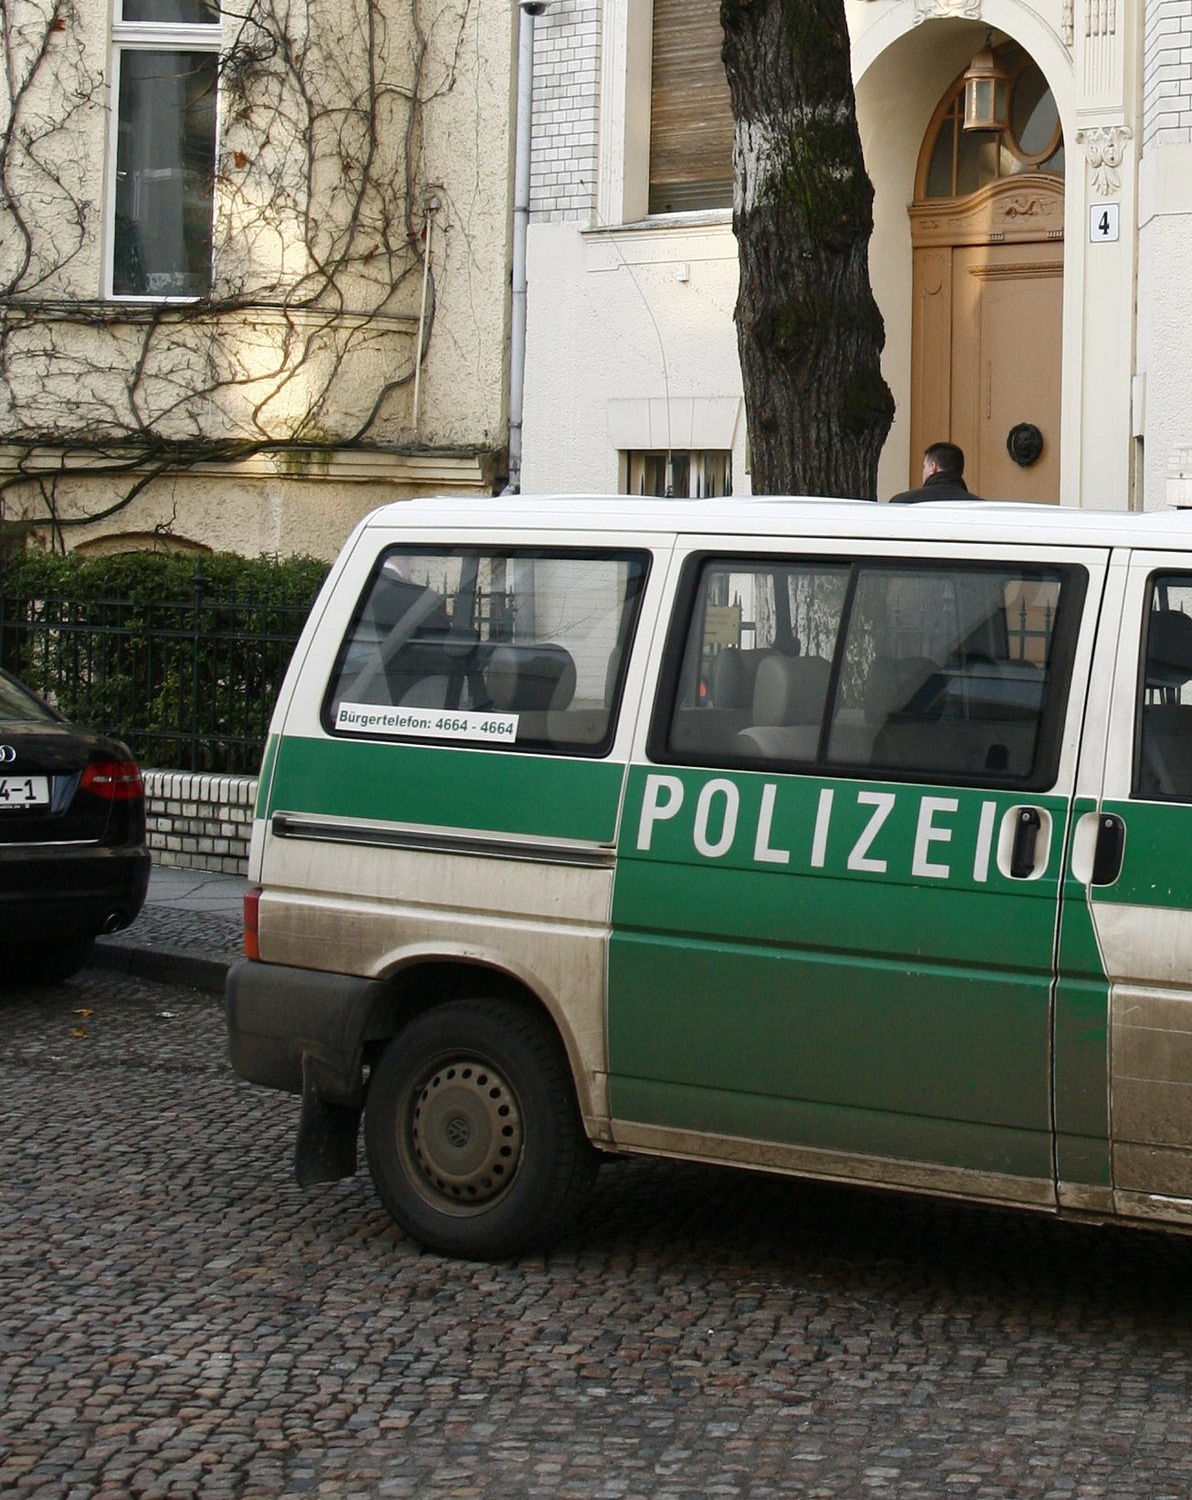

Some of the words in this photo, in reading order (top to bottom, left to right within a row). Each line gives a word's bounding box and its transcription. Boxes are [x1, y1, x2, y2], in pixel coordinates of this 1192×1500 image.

[1098, 211, 1110, 235] 4
[339, 710, 431, 729] Bürgertelefon:
[435, 717, 468, 732] 4664
[480, 721, 515, 736] 4664
[636, 774, 998, 883] POLIZEI
